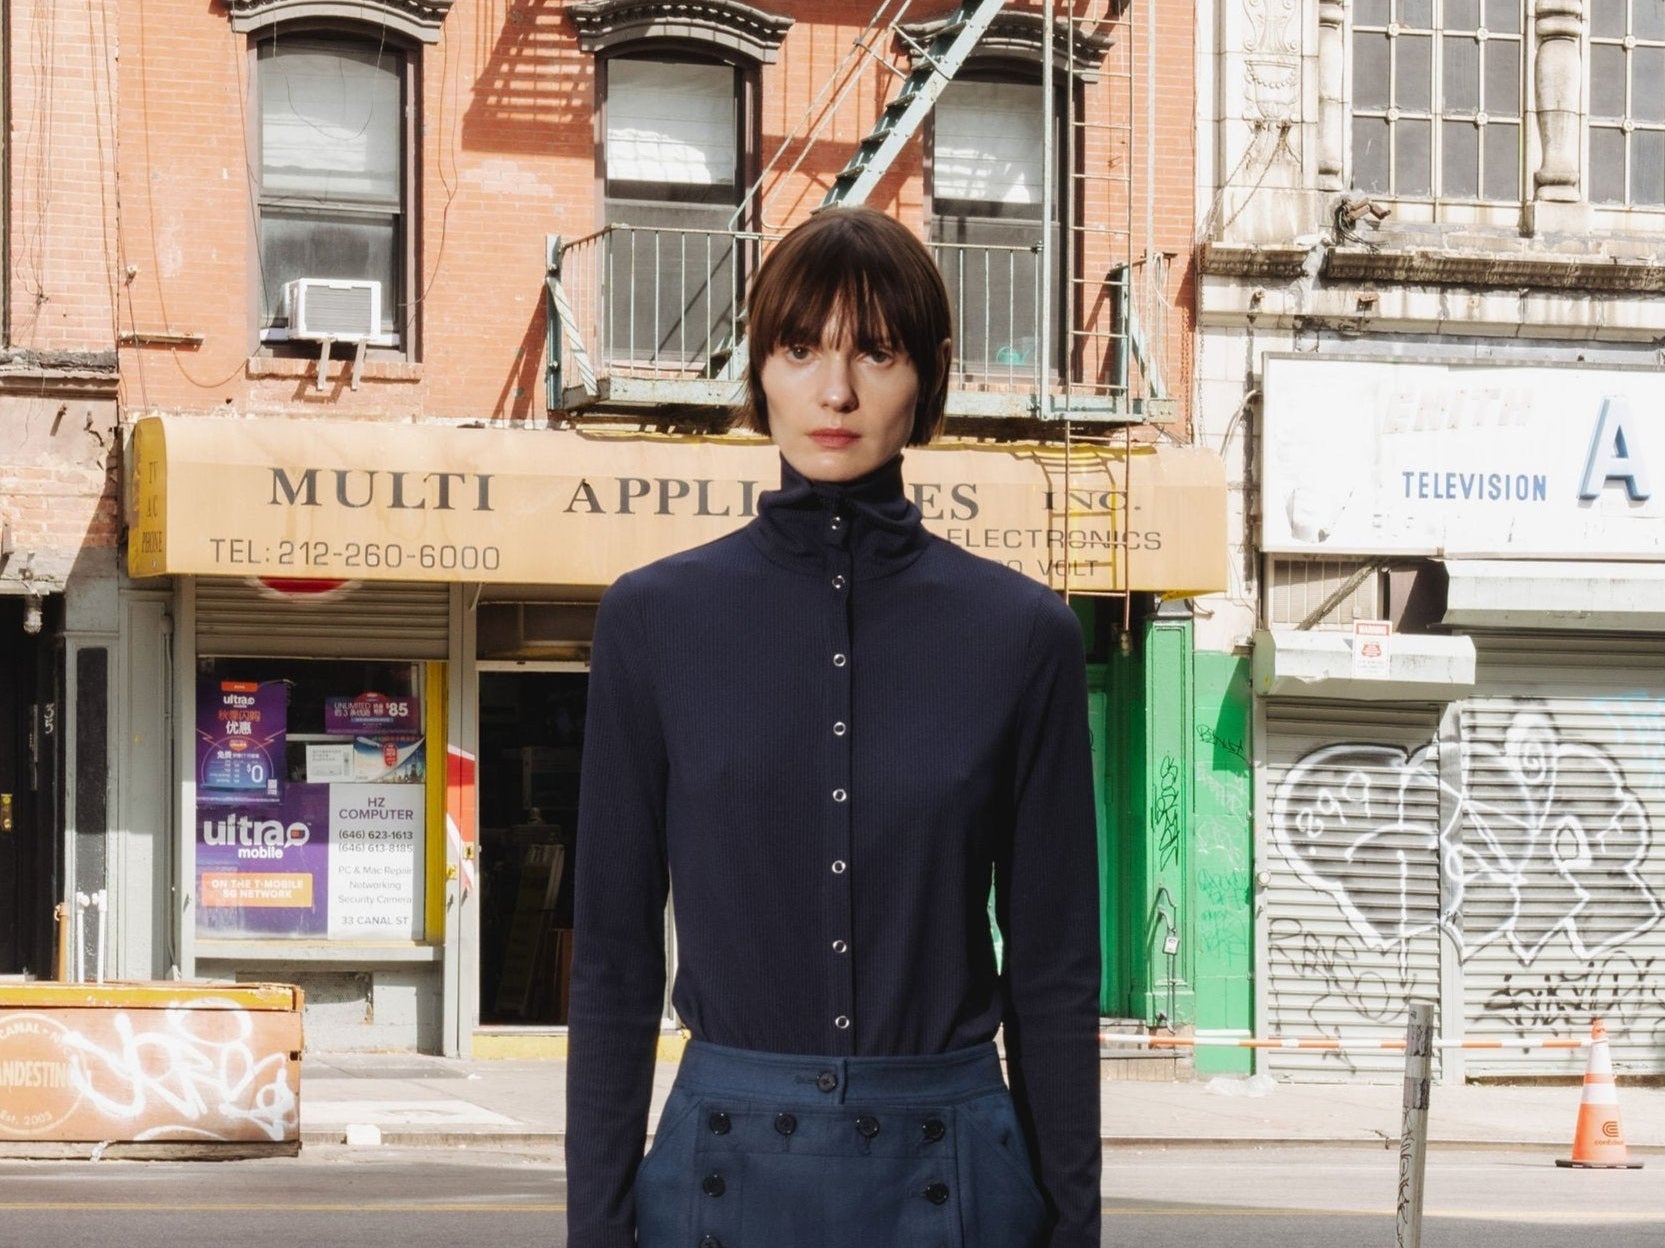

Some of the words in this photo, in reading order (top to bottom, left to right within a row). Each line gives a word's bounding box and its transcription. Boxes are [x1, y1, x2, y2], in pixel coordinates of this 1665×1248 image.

[1577, 395, 1652, 503] A
[1402, 470, 1548, 502] TELEVISION
[267, 466, 496, 513] MULTI
[562, 477, 979, 522] APPLIES
[141, 530, 162, 553] PHONE
[947, 528, 1162, 551] ELECTRONICS
[1037, 559, 1099, 576] VOLT
[44, 703, 55, 734] 35
[368, 797, 386, 808] HZ
[338, 808, 414, 820] COMPUTER
[203, 813, 285, 847] ultra
[338, 830, 365, 840] (646)
[368, 830, 413, 840] 623-1613
[238, 847, 284, 859] mobile
[211, 879, 228, 889] ON
[232, 879, 252, 889] THE
[349, 880, 402, 891] Networking
[239, 889, 293, 898] NETWORK
[356, 916, 392, 925] CANAL
[395, 916, 409, 925] ST
